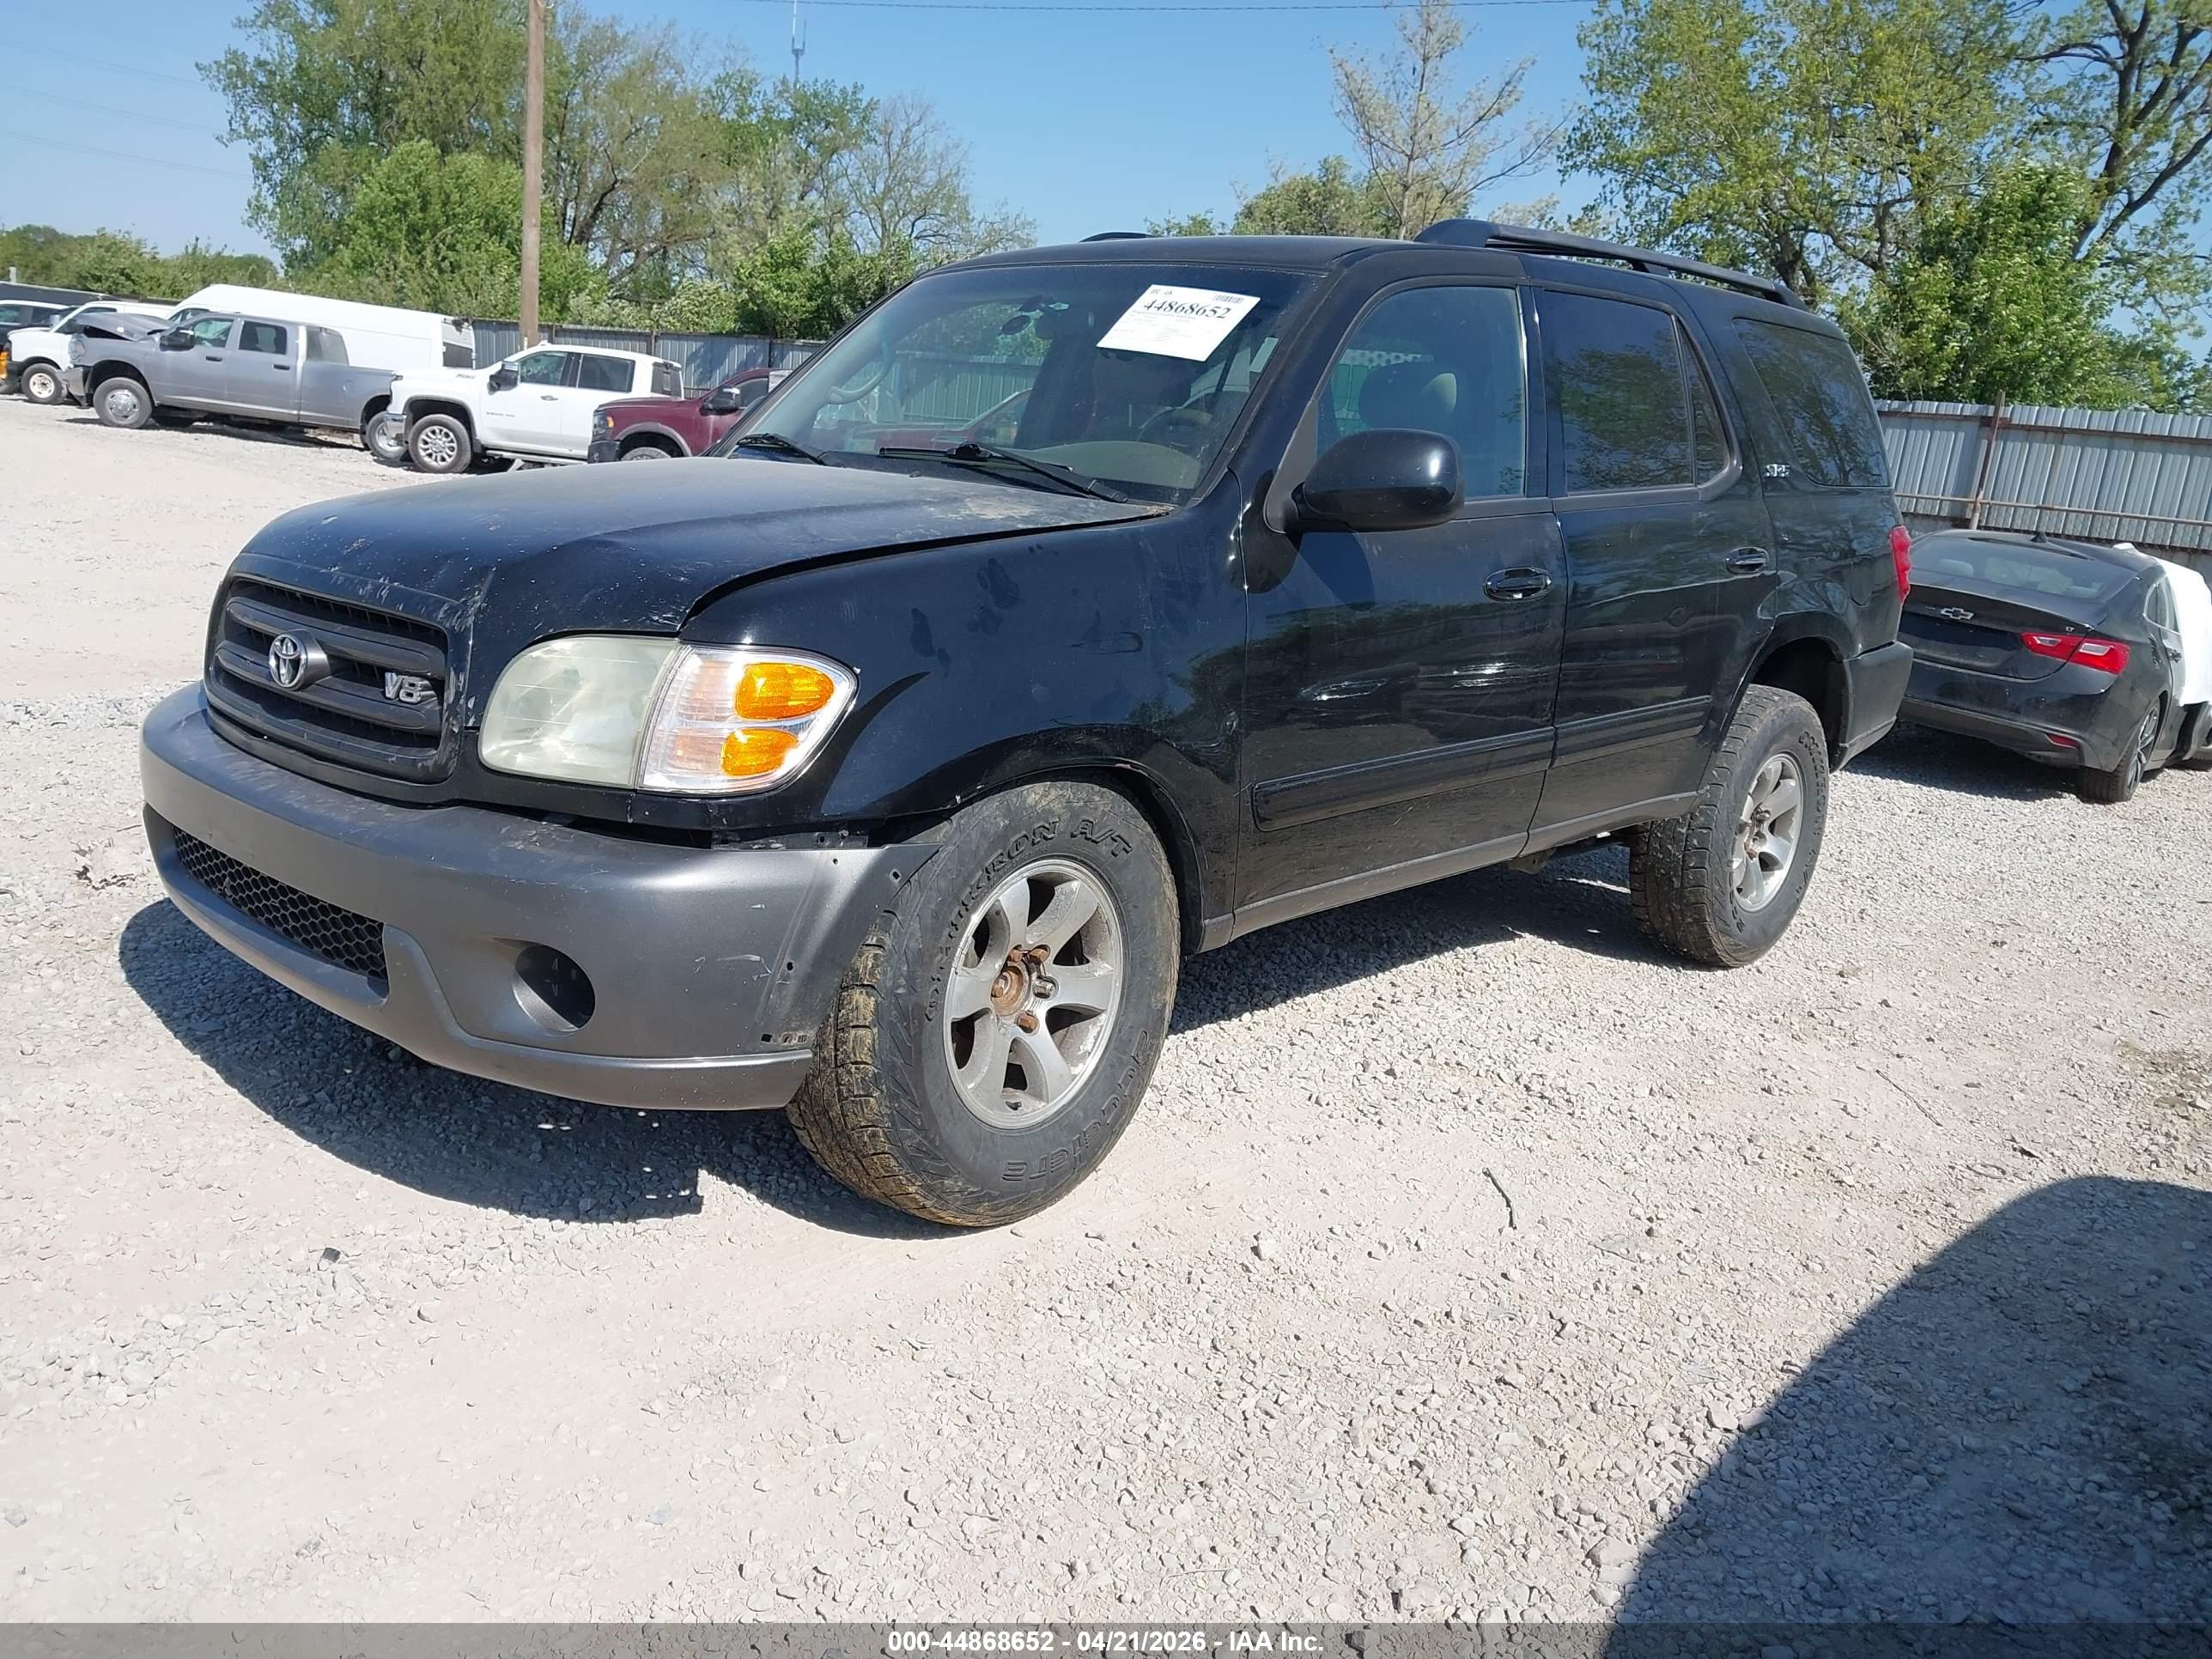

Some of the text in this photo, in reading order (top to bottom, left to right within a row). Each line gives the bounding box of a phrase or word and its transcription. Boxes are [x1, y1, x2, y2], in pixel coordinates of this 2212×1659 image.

[1143, 299, 1232, 319] 44868652
[384, 672, 438, 705] V8
[1070, 817, 1133, 858] A/T
